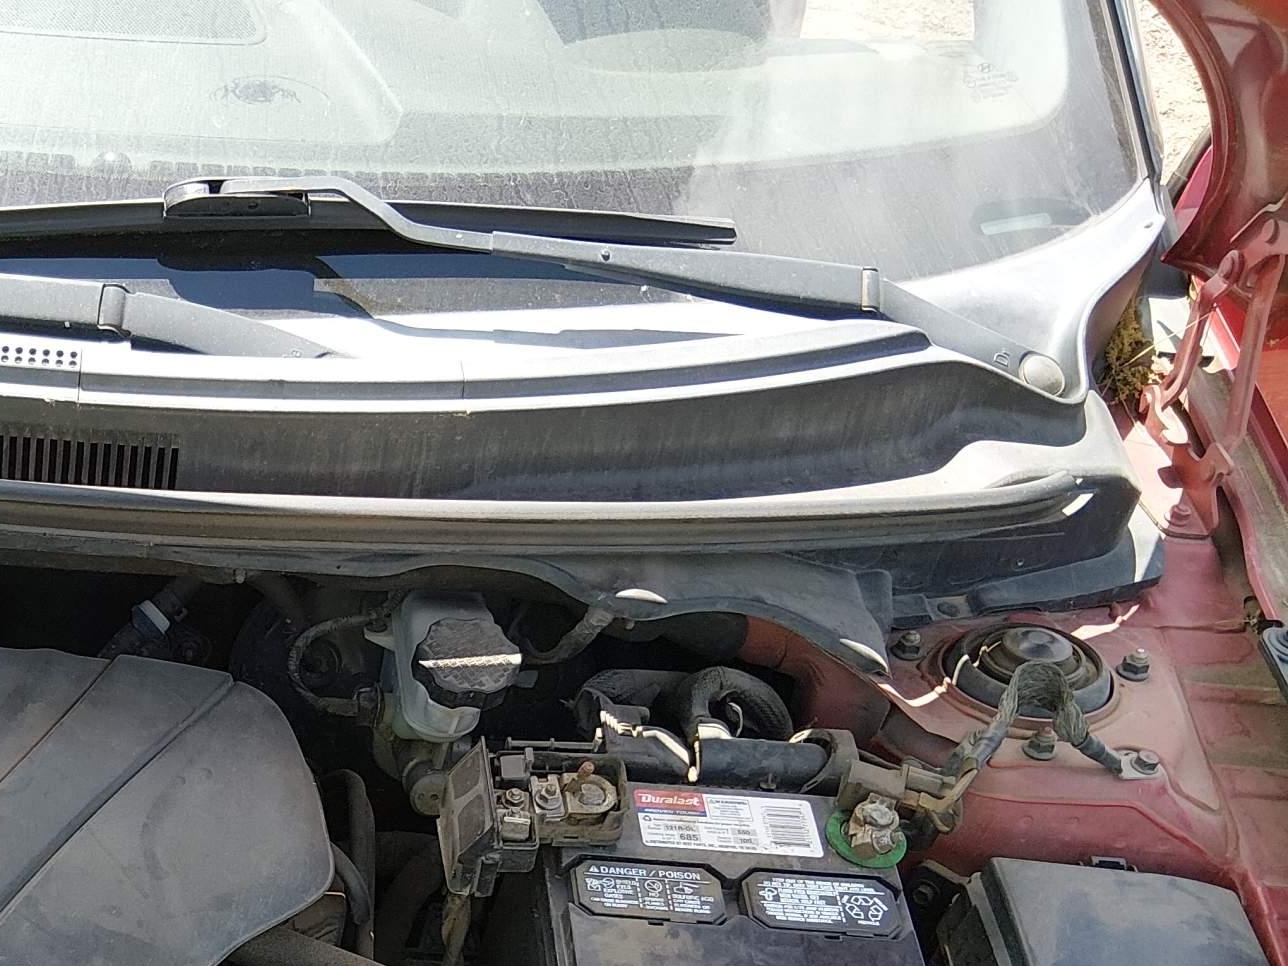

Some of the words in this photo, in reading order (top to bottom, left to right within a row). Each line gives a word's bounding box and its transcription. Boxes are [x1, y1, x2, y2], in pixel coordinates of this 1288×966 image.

[637, 793, 701, 806] Duralast
[679, 833, 699, 841] 685
[600, 866, 647, 877] DANGER
[658, 871, 701, 881] POISON
